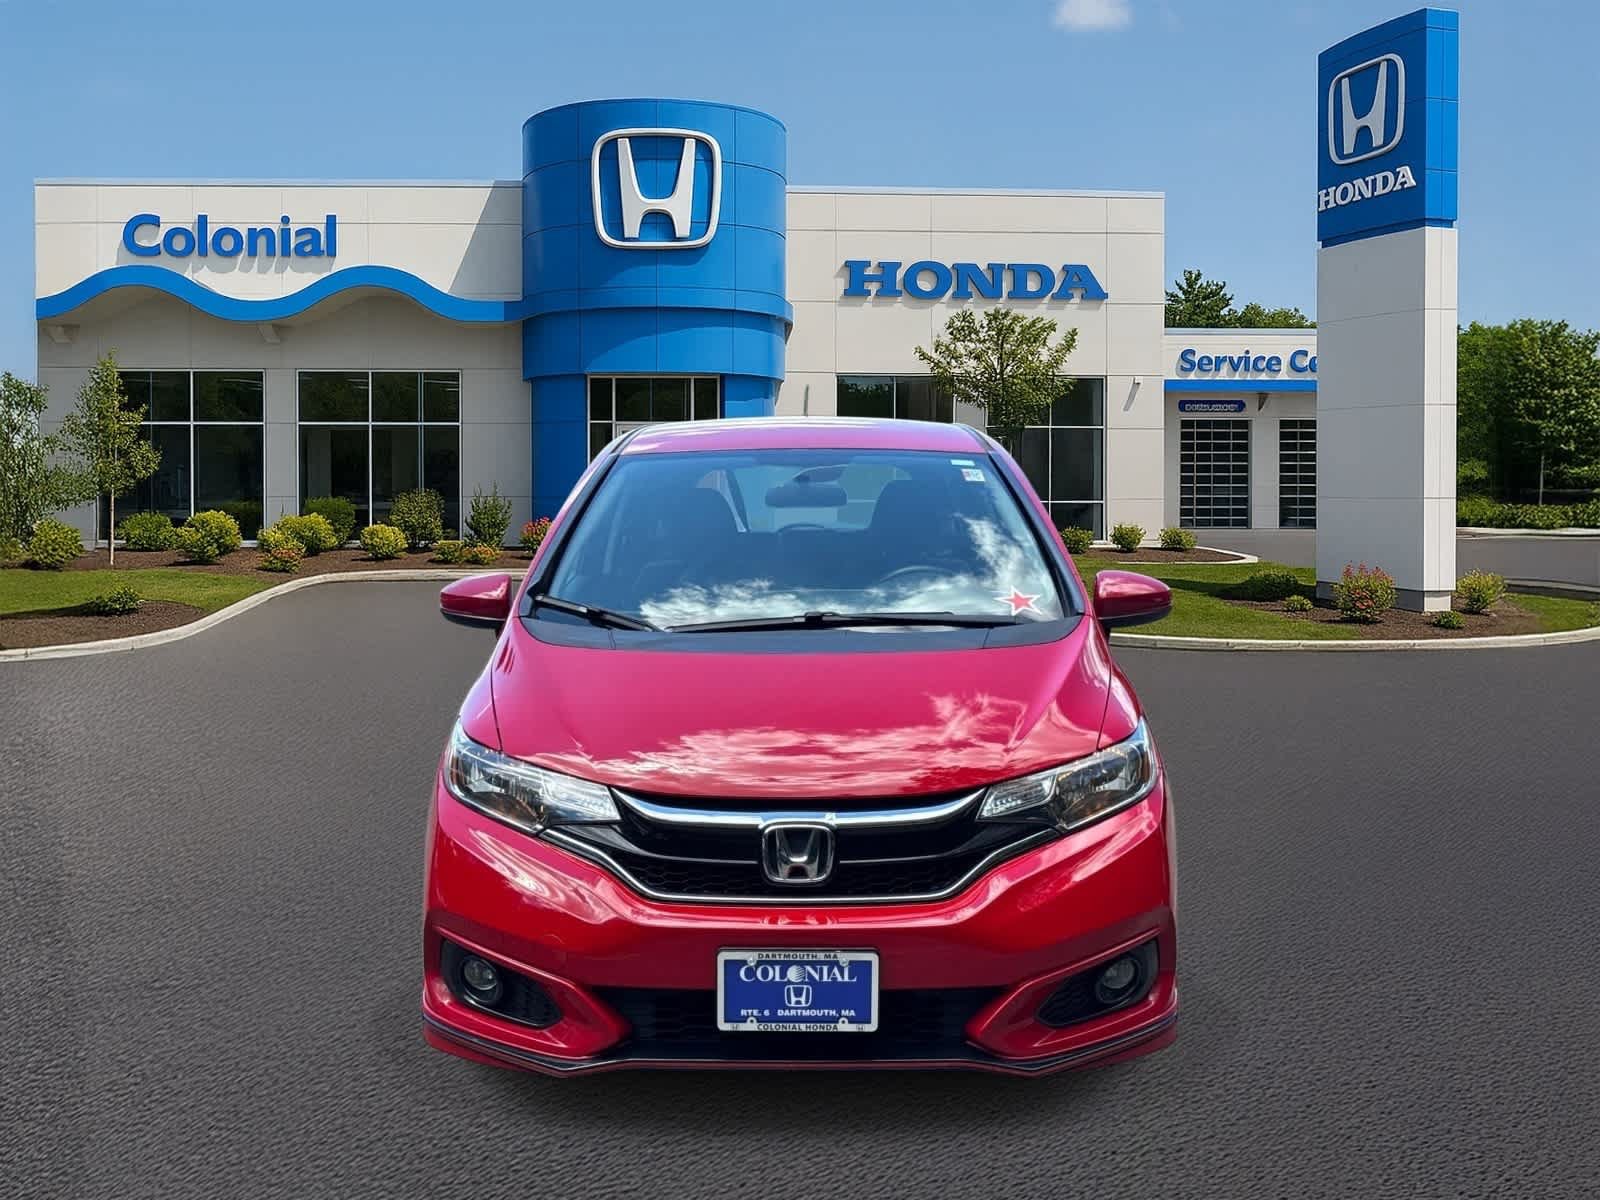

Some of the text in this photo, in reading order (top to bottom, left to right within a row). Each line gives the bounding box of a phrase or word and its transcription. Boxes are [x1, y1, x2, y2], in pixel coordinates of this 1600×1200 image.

[1318, 165, 1417, 212] HONDA
[122, 213, 338, 257] Colonial
[843, 260, 1109, 299] HONDA
[1180, 348, 1282, 373] Service
[739, 964, 857, 982] COLONIAL
[740, 1009, 761, 1017] RTE.
[763, 1009, 770, 1017] 6
[841, 1009, 856, 1017] MA
[757, 1023, 838, 1031] COLONIAL HONDA
